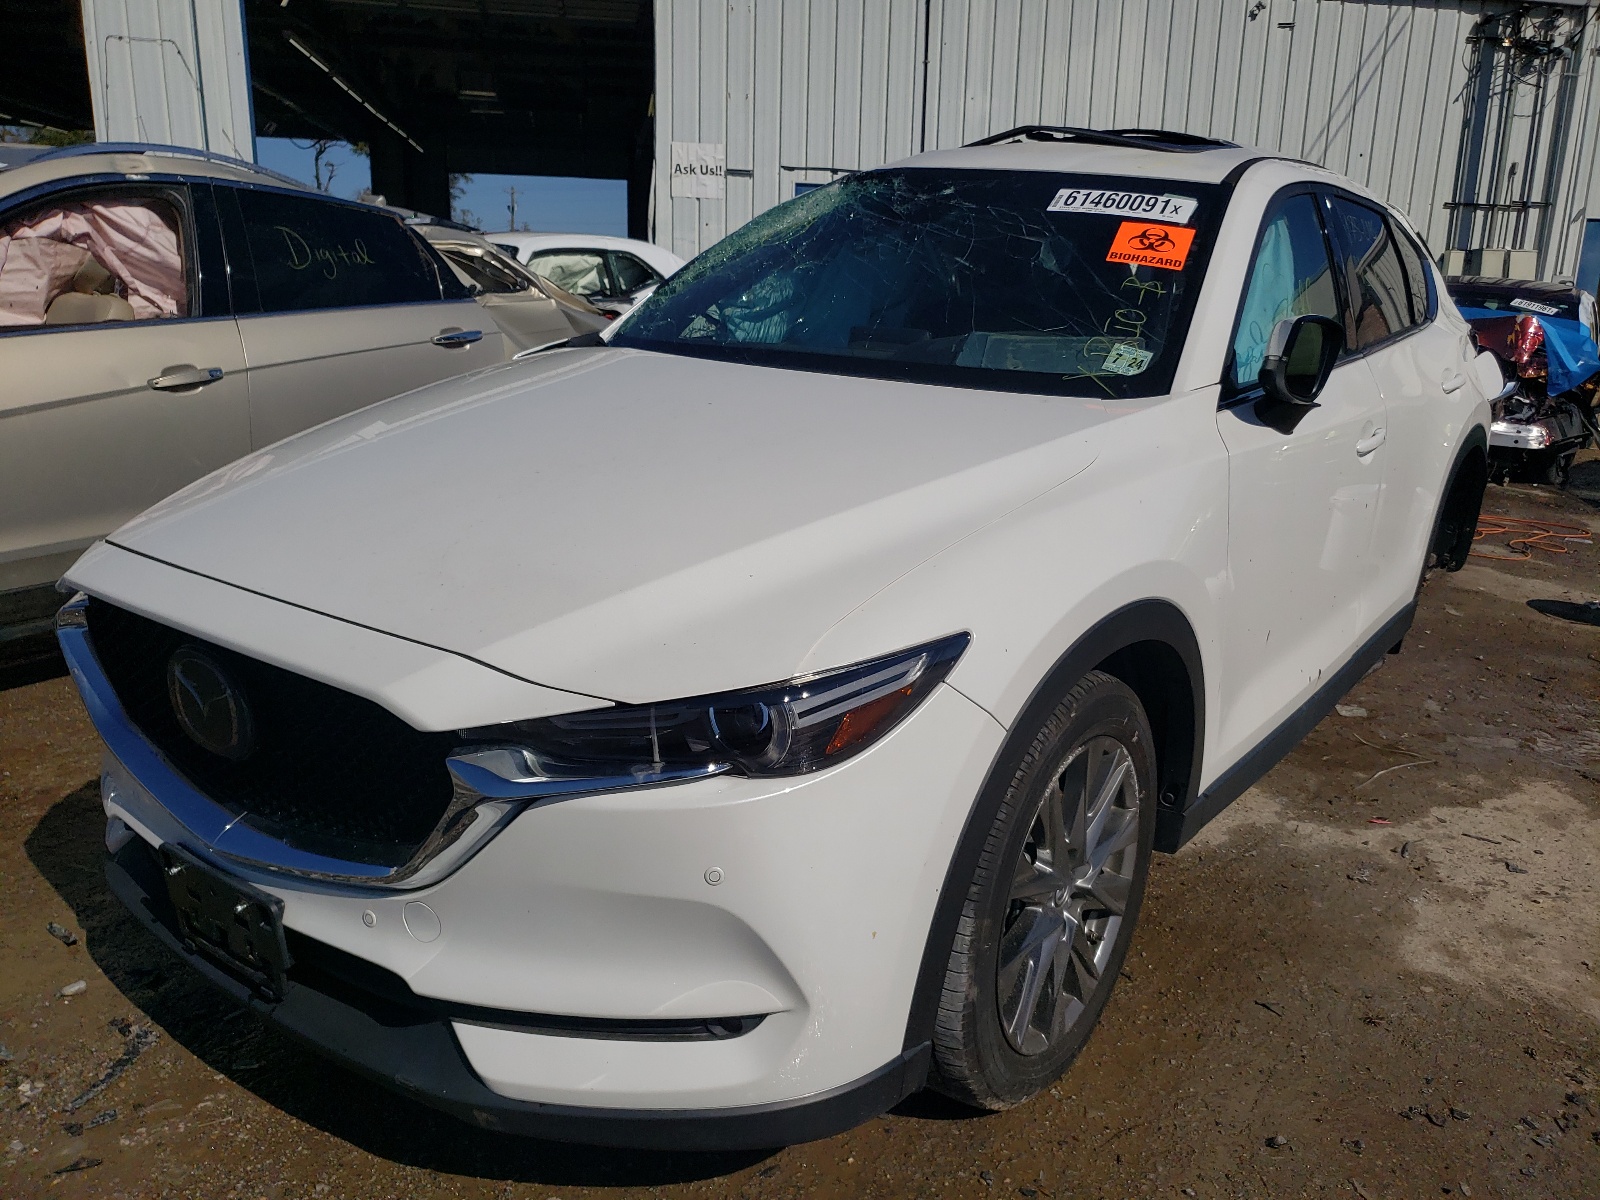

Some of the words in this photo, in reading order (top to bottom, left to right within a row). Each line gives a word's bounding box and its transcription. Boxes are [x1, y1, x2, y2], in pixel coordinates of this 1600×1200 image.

[674, 163, 697, 175] Ask
[700, 164, 722, 176] Us!!
[274, 225, 376, 279] Digital
[1109, 251, 1182, 268] BIOHAZARD
[1112, 352, 1123, 364] 7
[1127, 357, 1145, 371] 24
